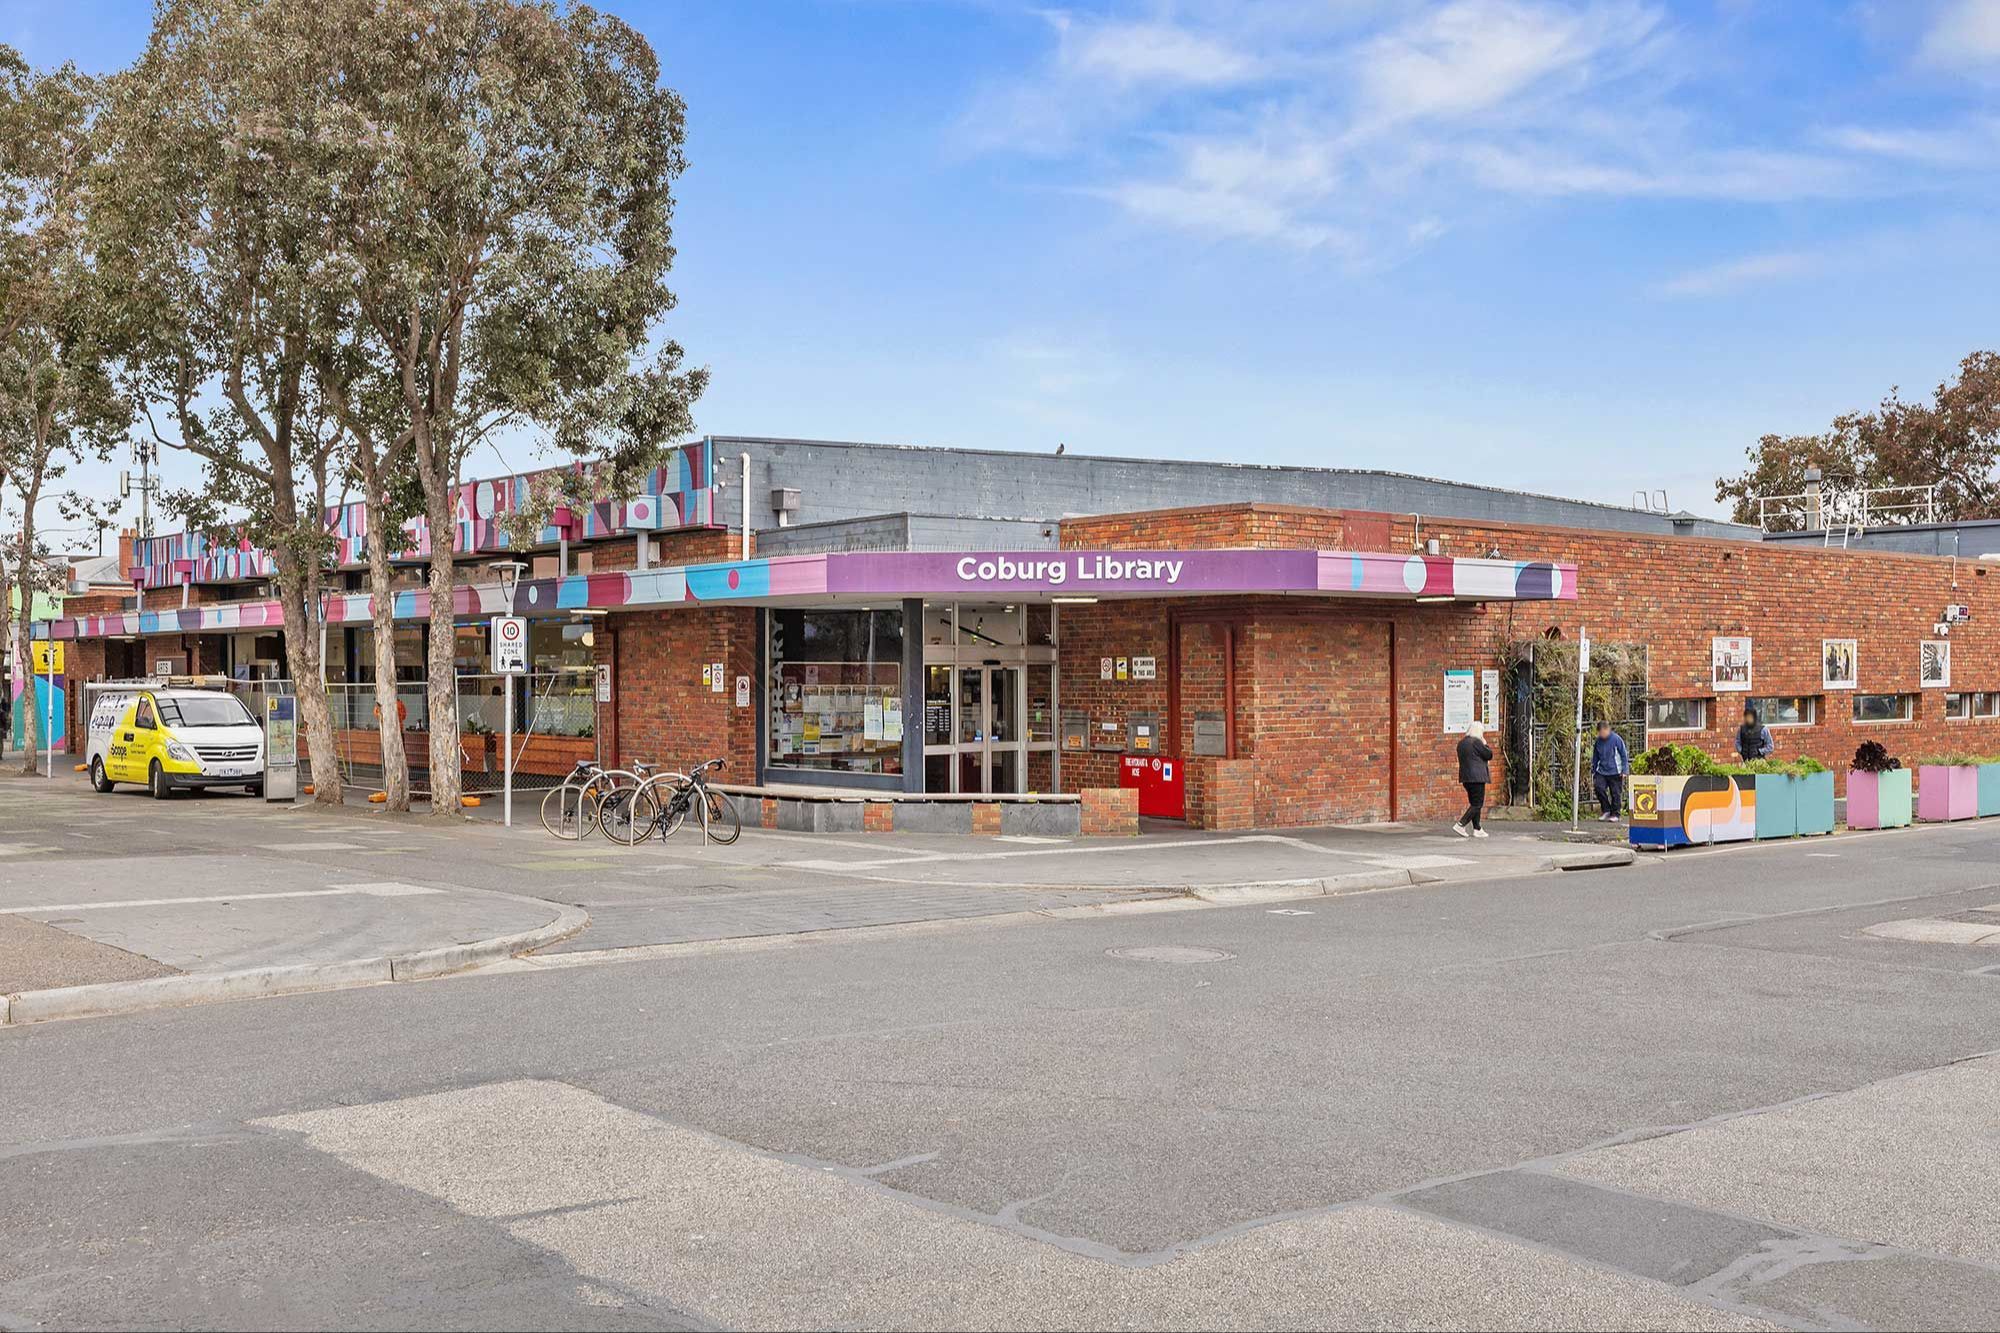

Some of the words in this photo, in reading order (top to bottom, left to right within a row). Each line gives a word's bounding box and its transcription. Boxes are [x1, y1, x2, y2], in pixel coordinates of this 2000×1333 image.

[956, 556, 1066, 584] Coburg
[1077, 556, 1184, 584] Library
[506, 626, 516, 636] 10
[499, 641, 523, 649] SHARED
[771, 612, 784, 760] LIBRARY
